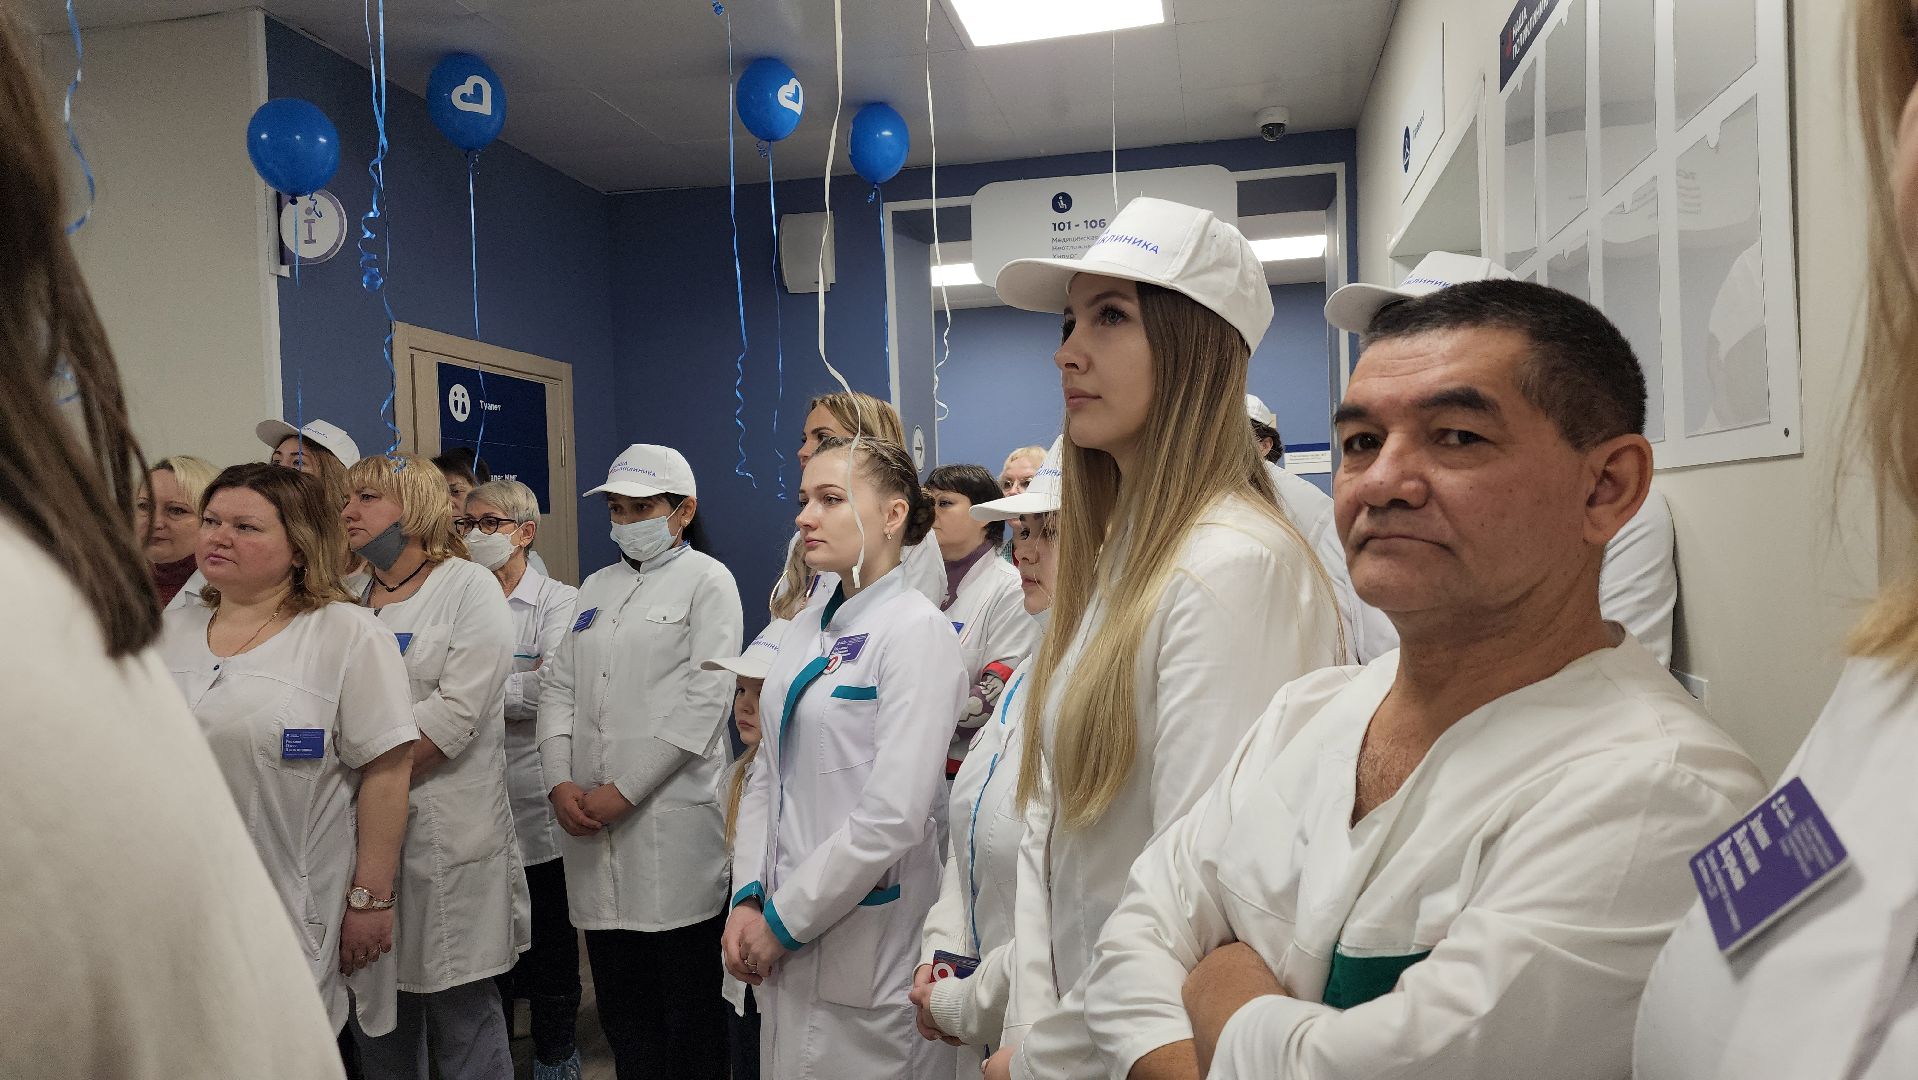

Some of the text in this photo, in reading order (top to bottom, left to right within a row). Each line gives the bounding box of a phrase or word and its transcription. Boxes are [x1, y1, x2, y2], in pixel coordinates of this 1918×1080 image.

[1052, 221, 1071, 231] 101
[1084, 219, 1106, 229] 106
[479, 400, 502, 411] Туалет
